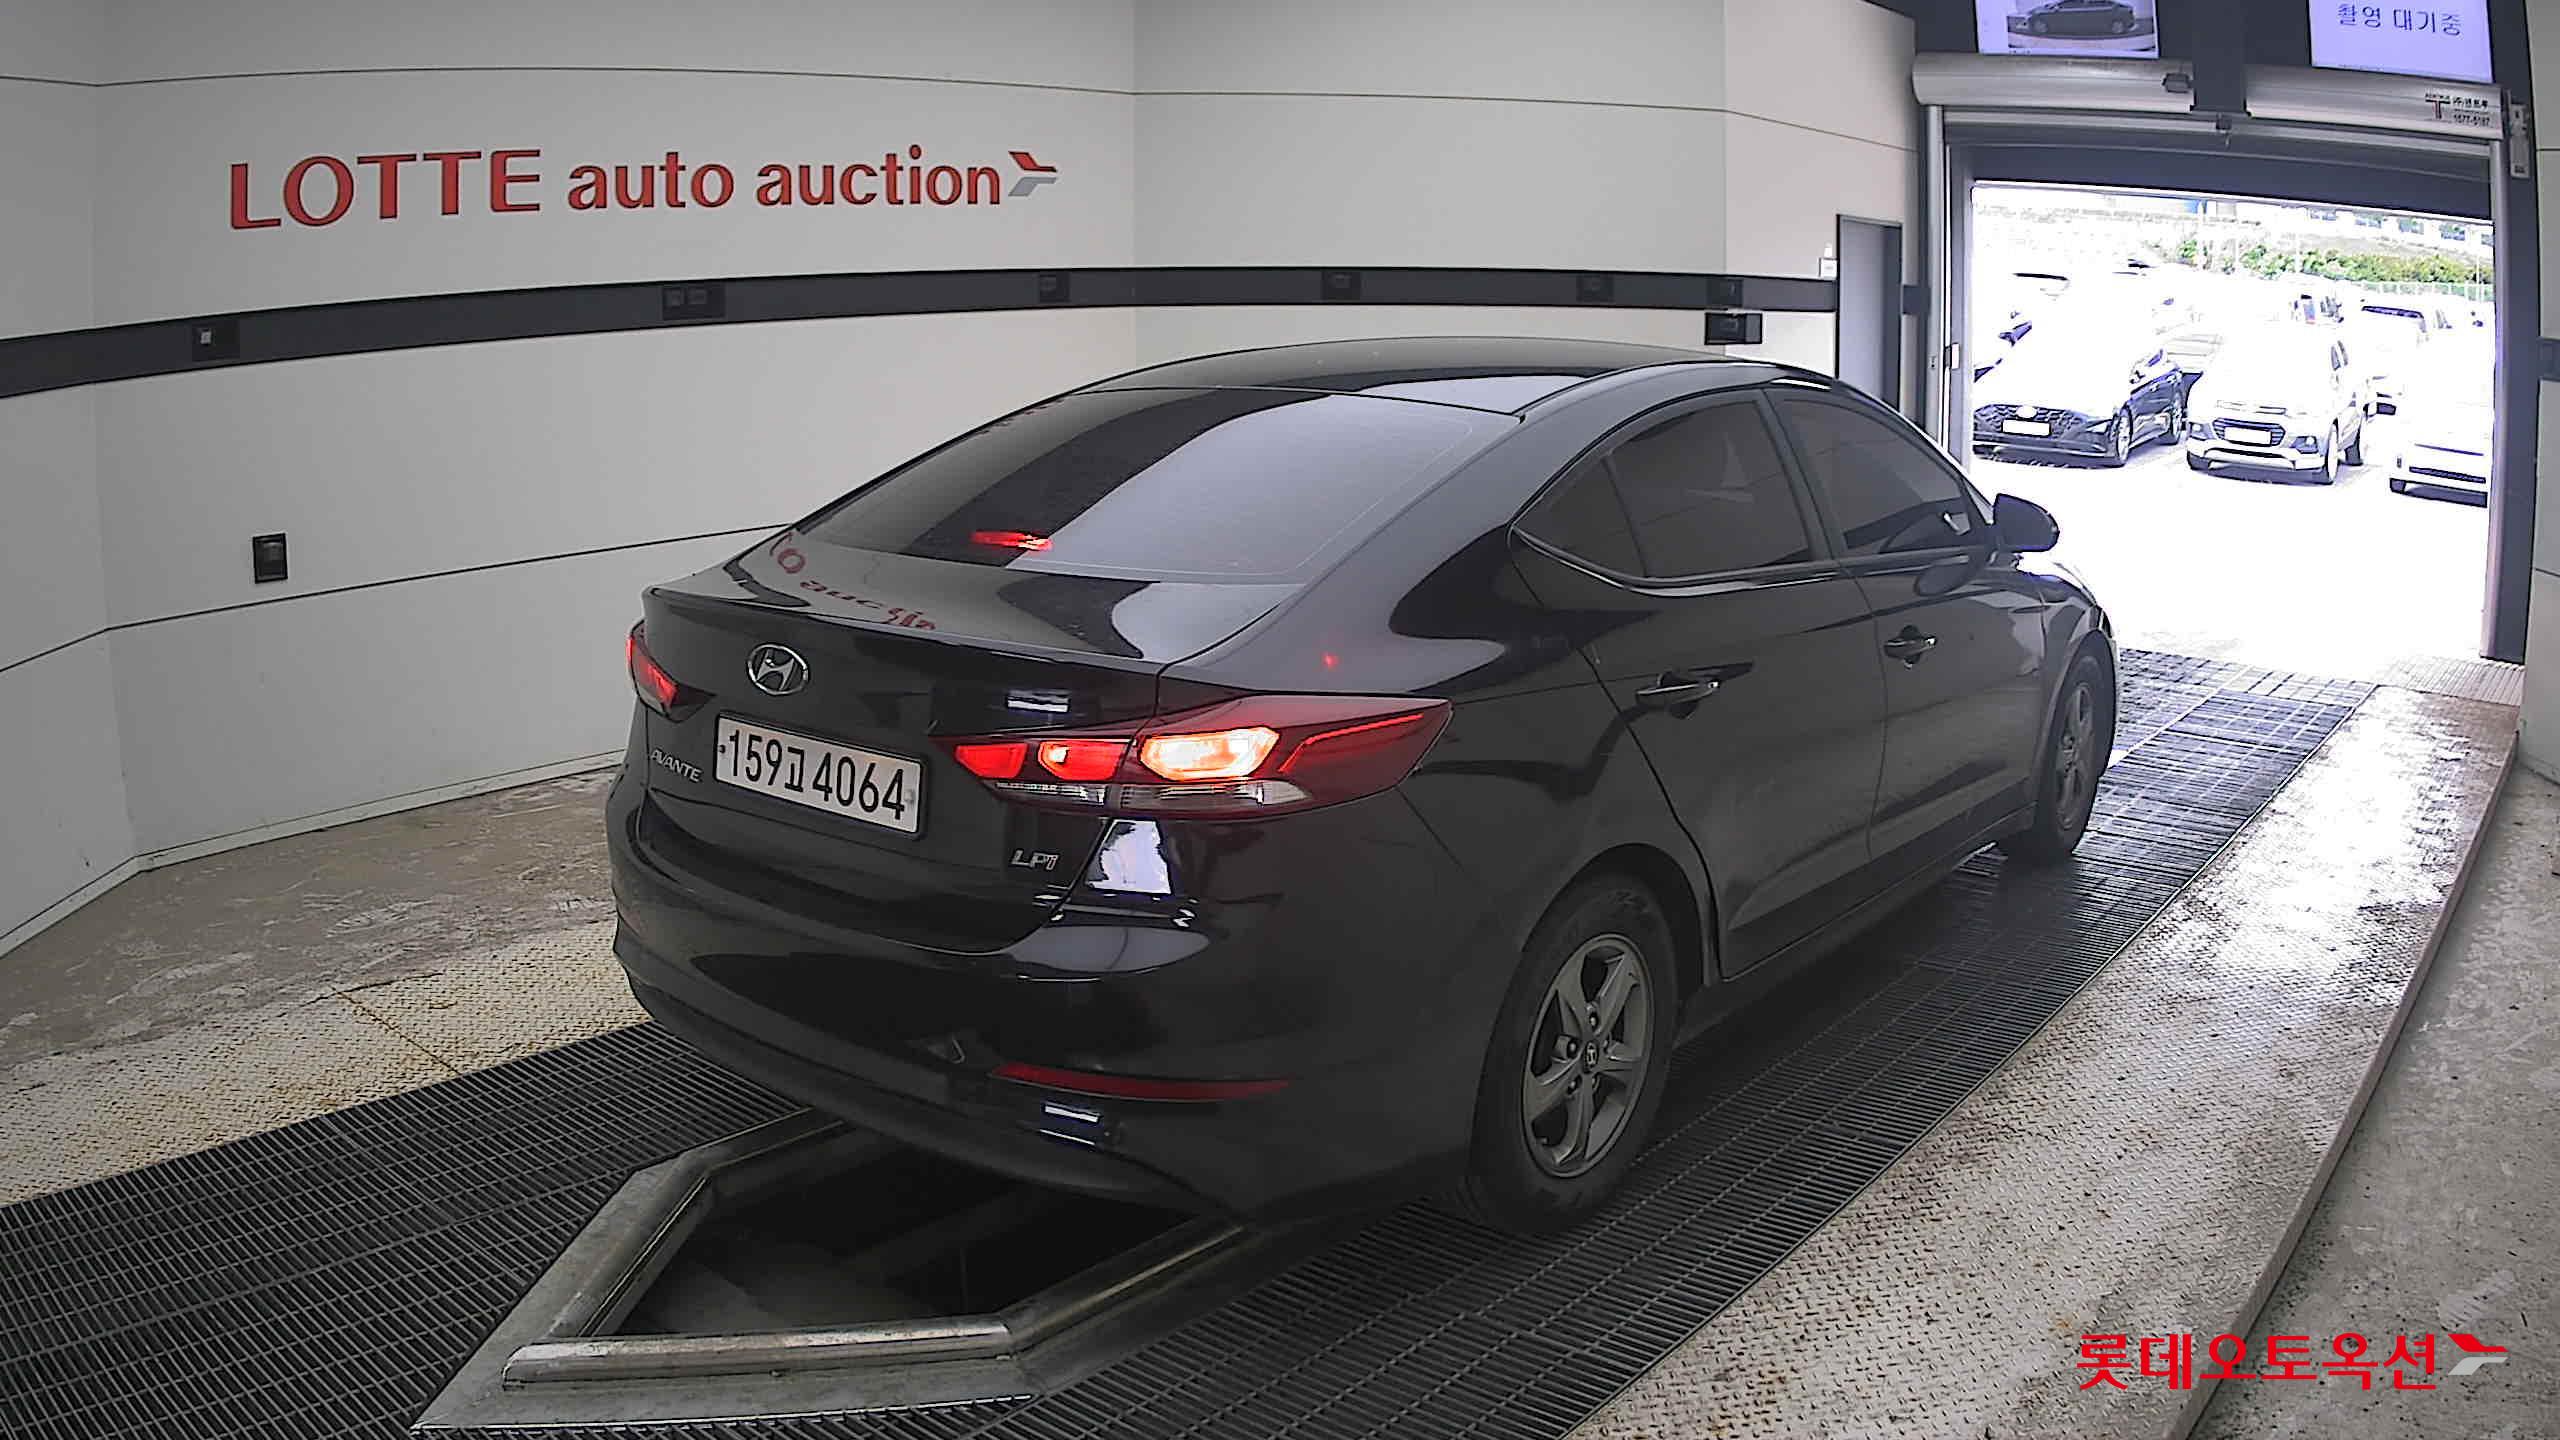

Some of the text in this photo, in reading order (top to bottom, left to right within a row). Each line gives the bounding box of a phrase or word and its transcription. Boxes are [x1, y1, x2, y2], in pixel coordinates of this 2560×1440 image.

[2337, 3, 2462, 37] 촬영 대기중
[229, 143, 1003, 230] LOTTE auto auction
[650, 748, 704, 784] AVANTE
[728, 728, 907, 821] 159고4064
